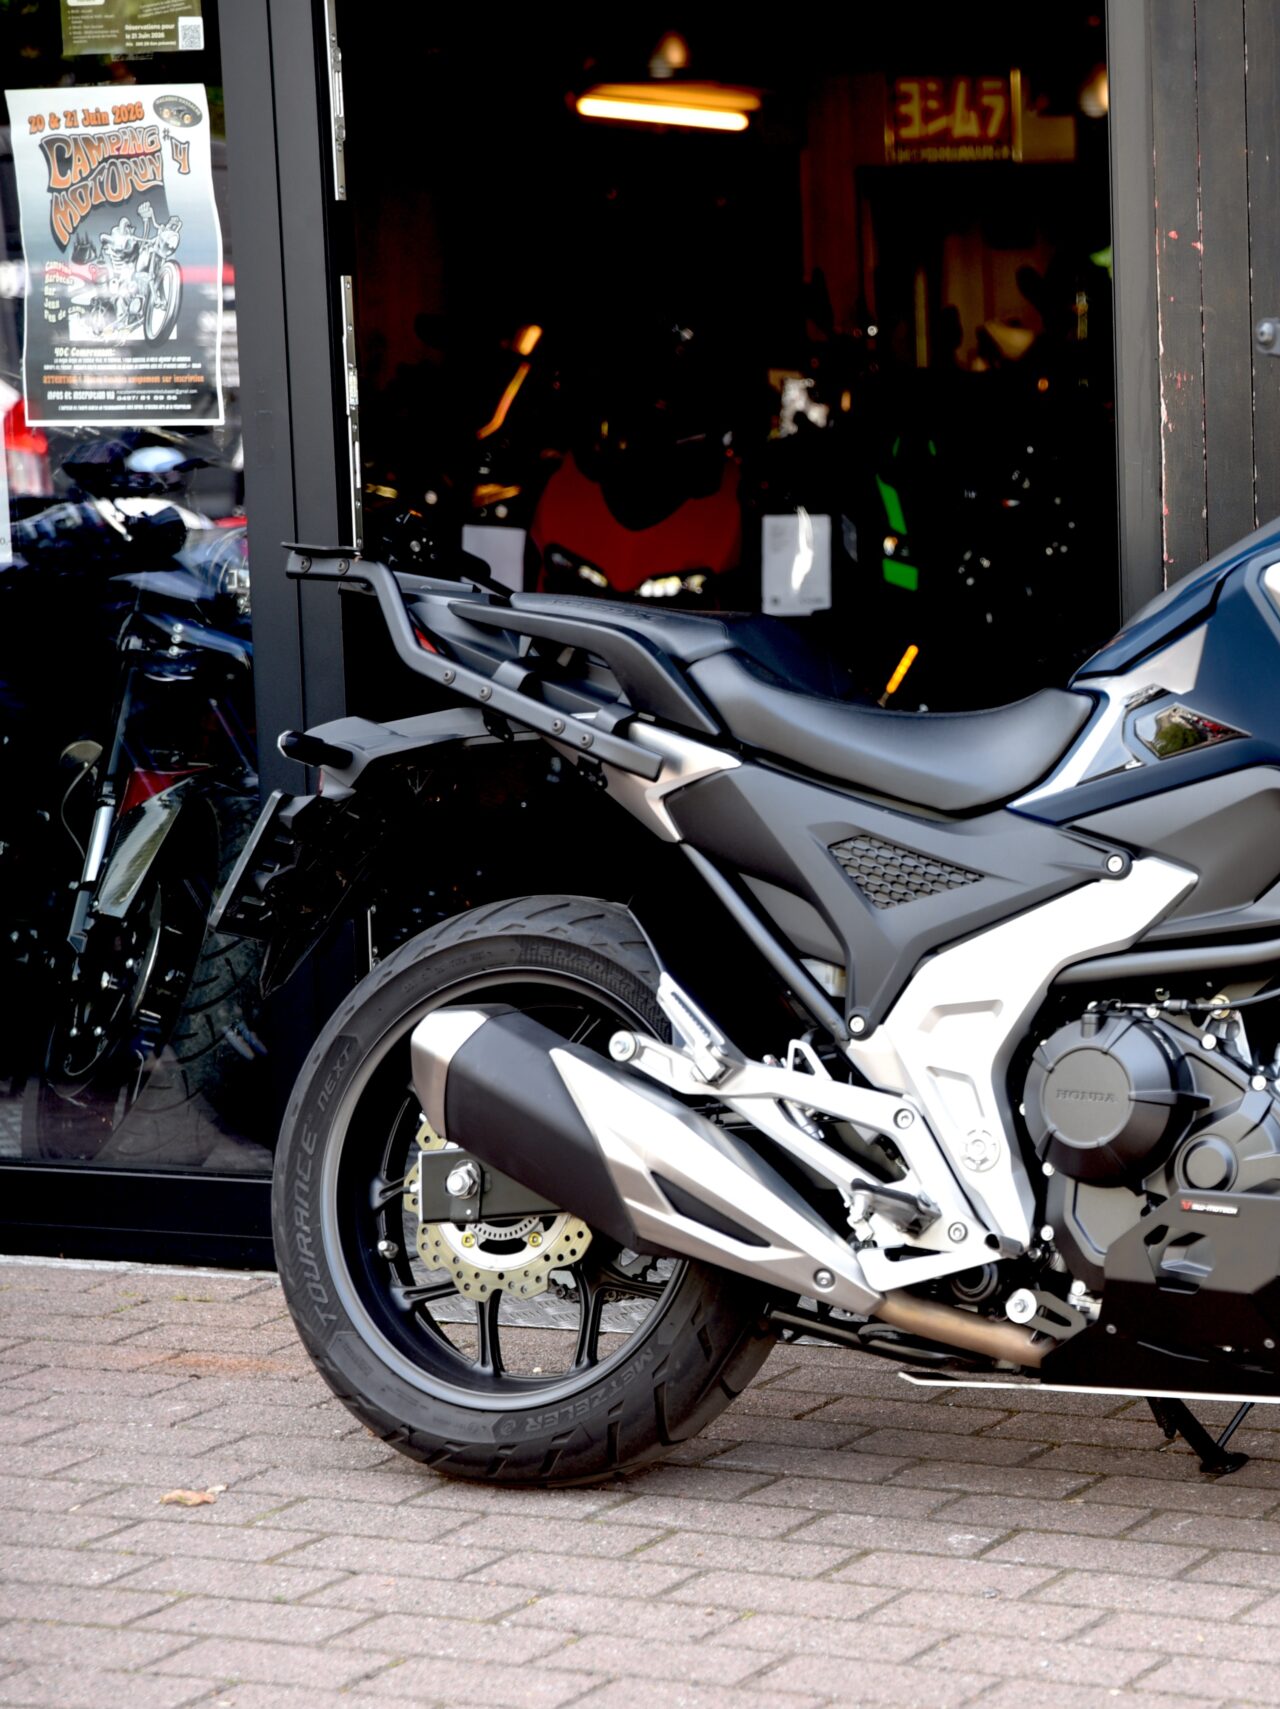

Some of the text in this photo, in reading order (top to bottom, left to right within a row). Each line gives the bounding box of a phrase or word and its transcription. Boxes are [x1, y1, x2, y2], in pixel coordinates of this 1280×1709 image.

[28, 101, 145, 134] 20 & 21 Juin 2026
[898, 80, 1005, 138] ヨシムラ
[40, 125, 161, 189] CAMPING
[51, 153, 164, 246] MOTORUN
[1056, 1088, 1118, 1104] HONDA
[289, 1046, 355, 1327] TOURANCE NEXT
[524, 1348, 656, 1434] METZELER
